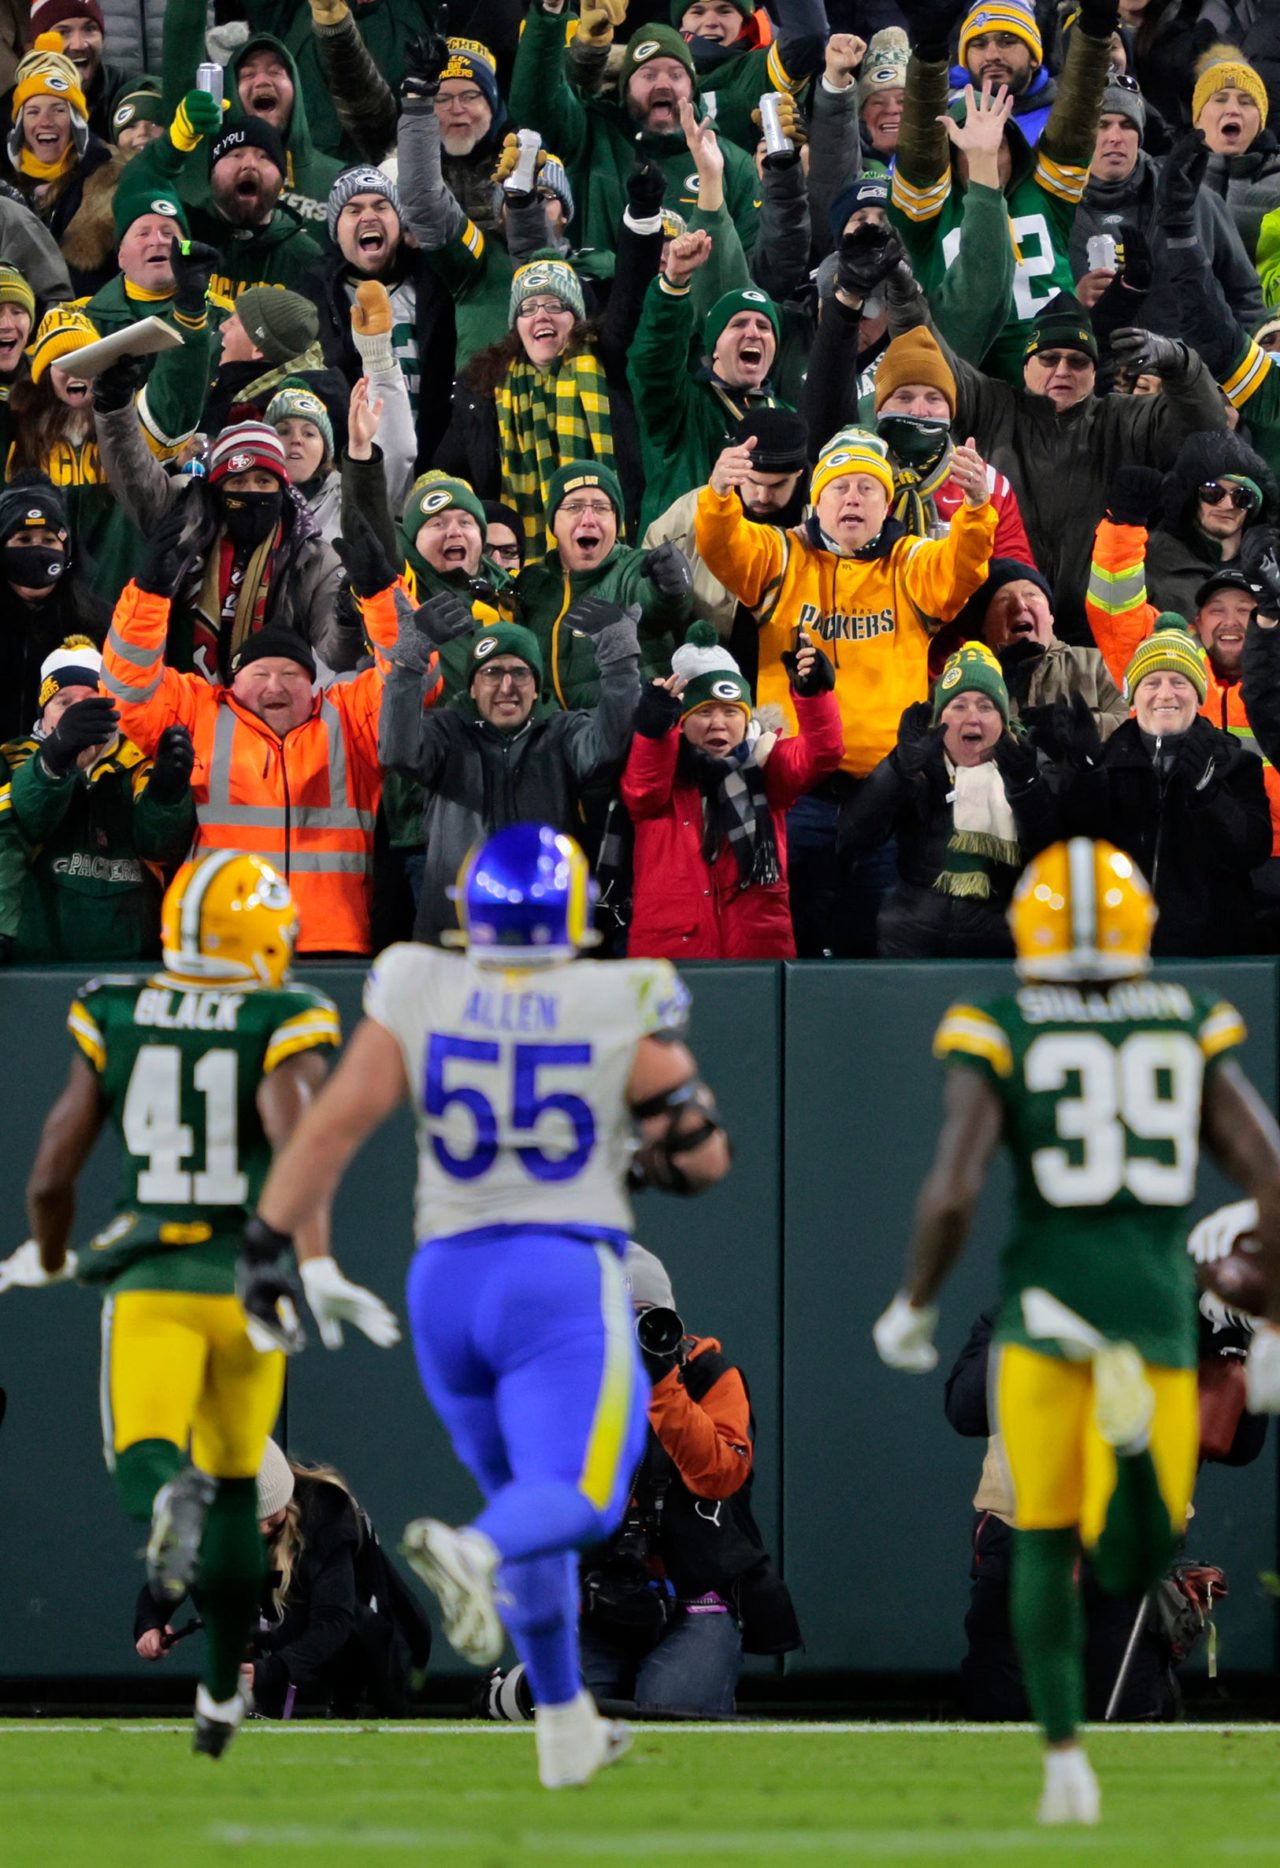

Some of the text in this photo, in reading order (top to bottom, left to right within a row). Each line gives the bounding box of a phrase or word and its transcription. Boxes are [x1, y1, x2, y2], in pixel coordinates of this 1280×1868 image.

[420, 489, 452, 514] G
[799, 604, 895, 640] PACKERS
[711, 680, 741, 701] G
[135, 989, 242, 1031] BLACK
[461, 990, 557, 1031] ALLEN
[123, 1045, 248, 1205] 41
[425, 1033, 596, 1182] 55
[1024, 1034, 1199, 1207] 39
